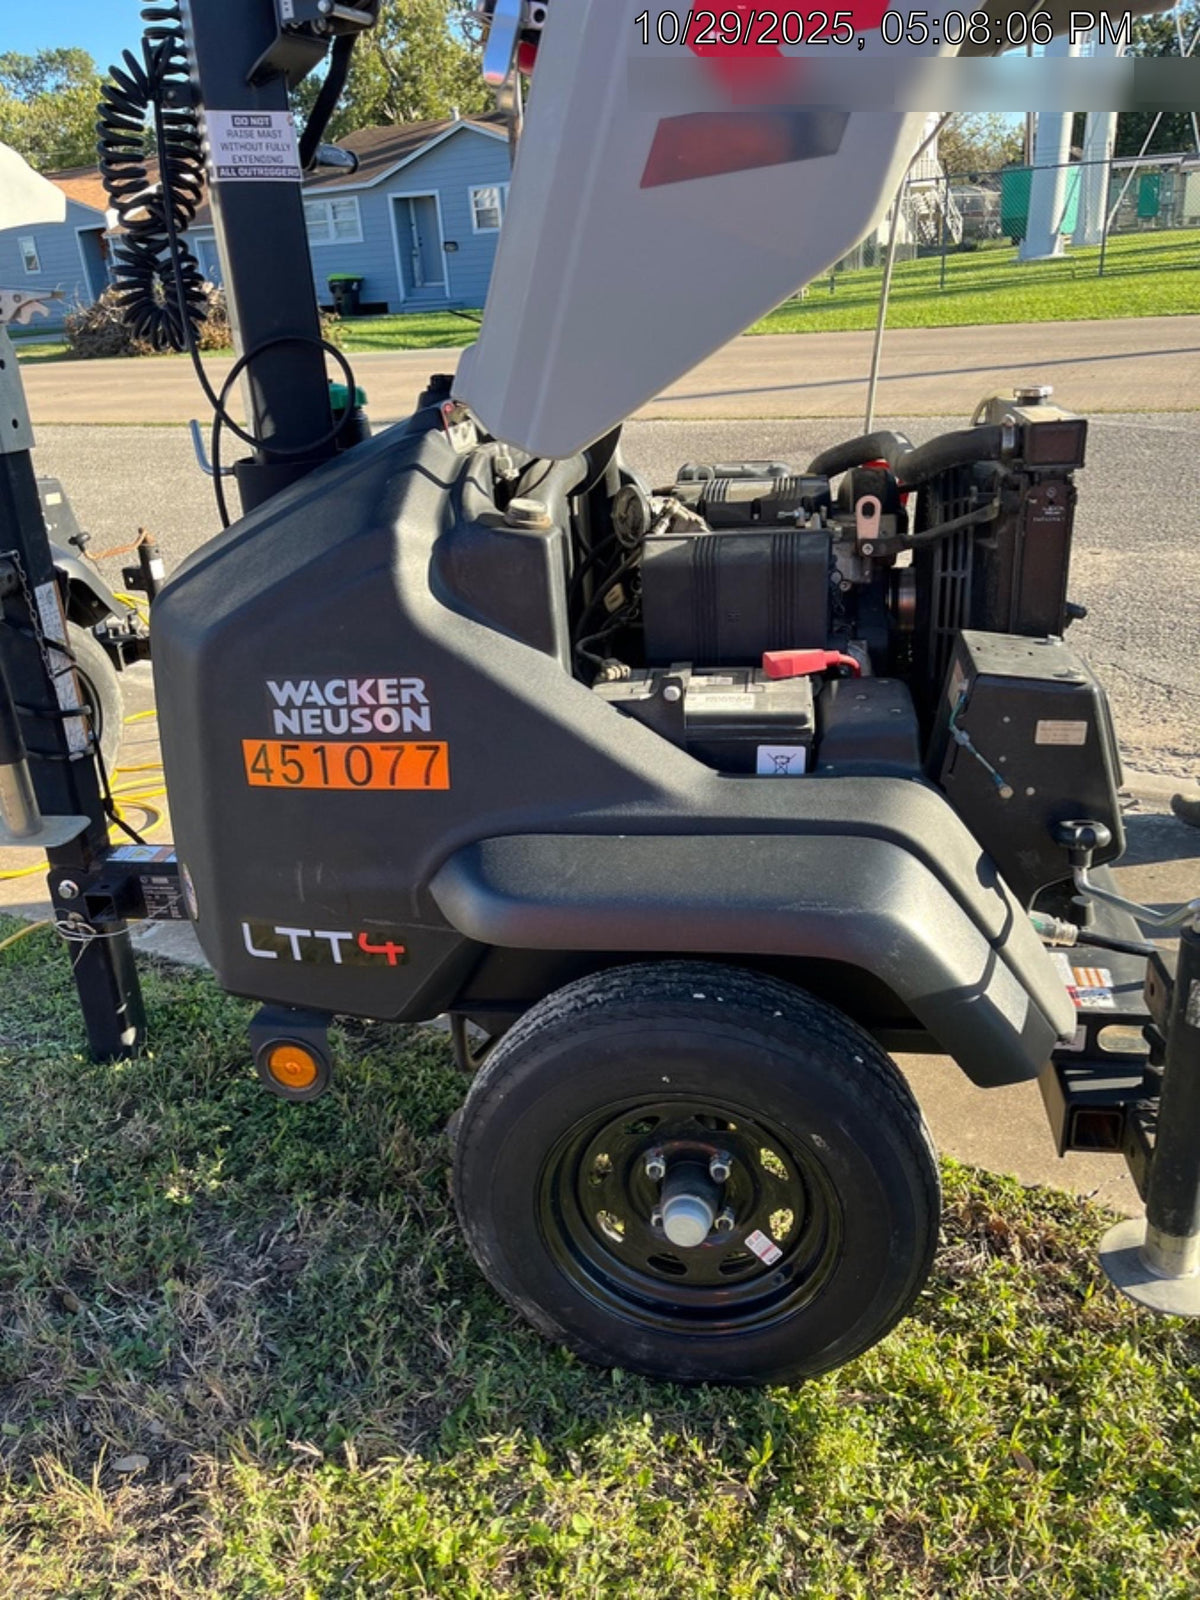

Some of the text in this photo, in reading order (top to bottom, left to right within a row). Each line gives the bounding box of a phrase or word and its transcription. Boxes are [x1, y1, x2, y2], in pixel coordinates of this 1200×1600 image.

[233, 116, 270, 126] DO NOT
[227, 129, 283, 139] RAISE MAST
[220, 142, 291, 152] WITHOUT FULLY
[231, 154, 284, 164] EXTENDING
[220, 167, 300, 177] ALL OUTRIGGERS
[266, 677, 430, 707] WACKER
[273, 705, 432, 735] NEUSON
[250, 742, 441, 787] 451077
[241, 922, 405, 967] LTT4
